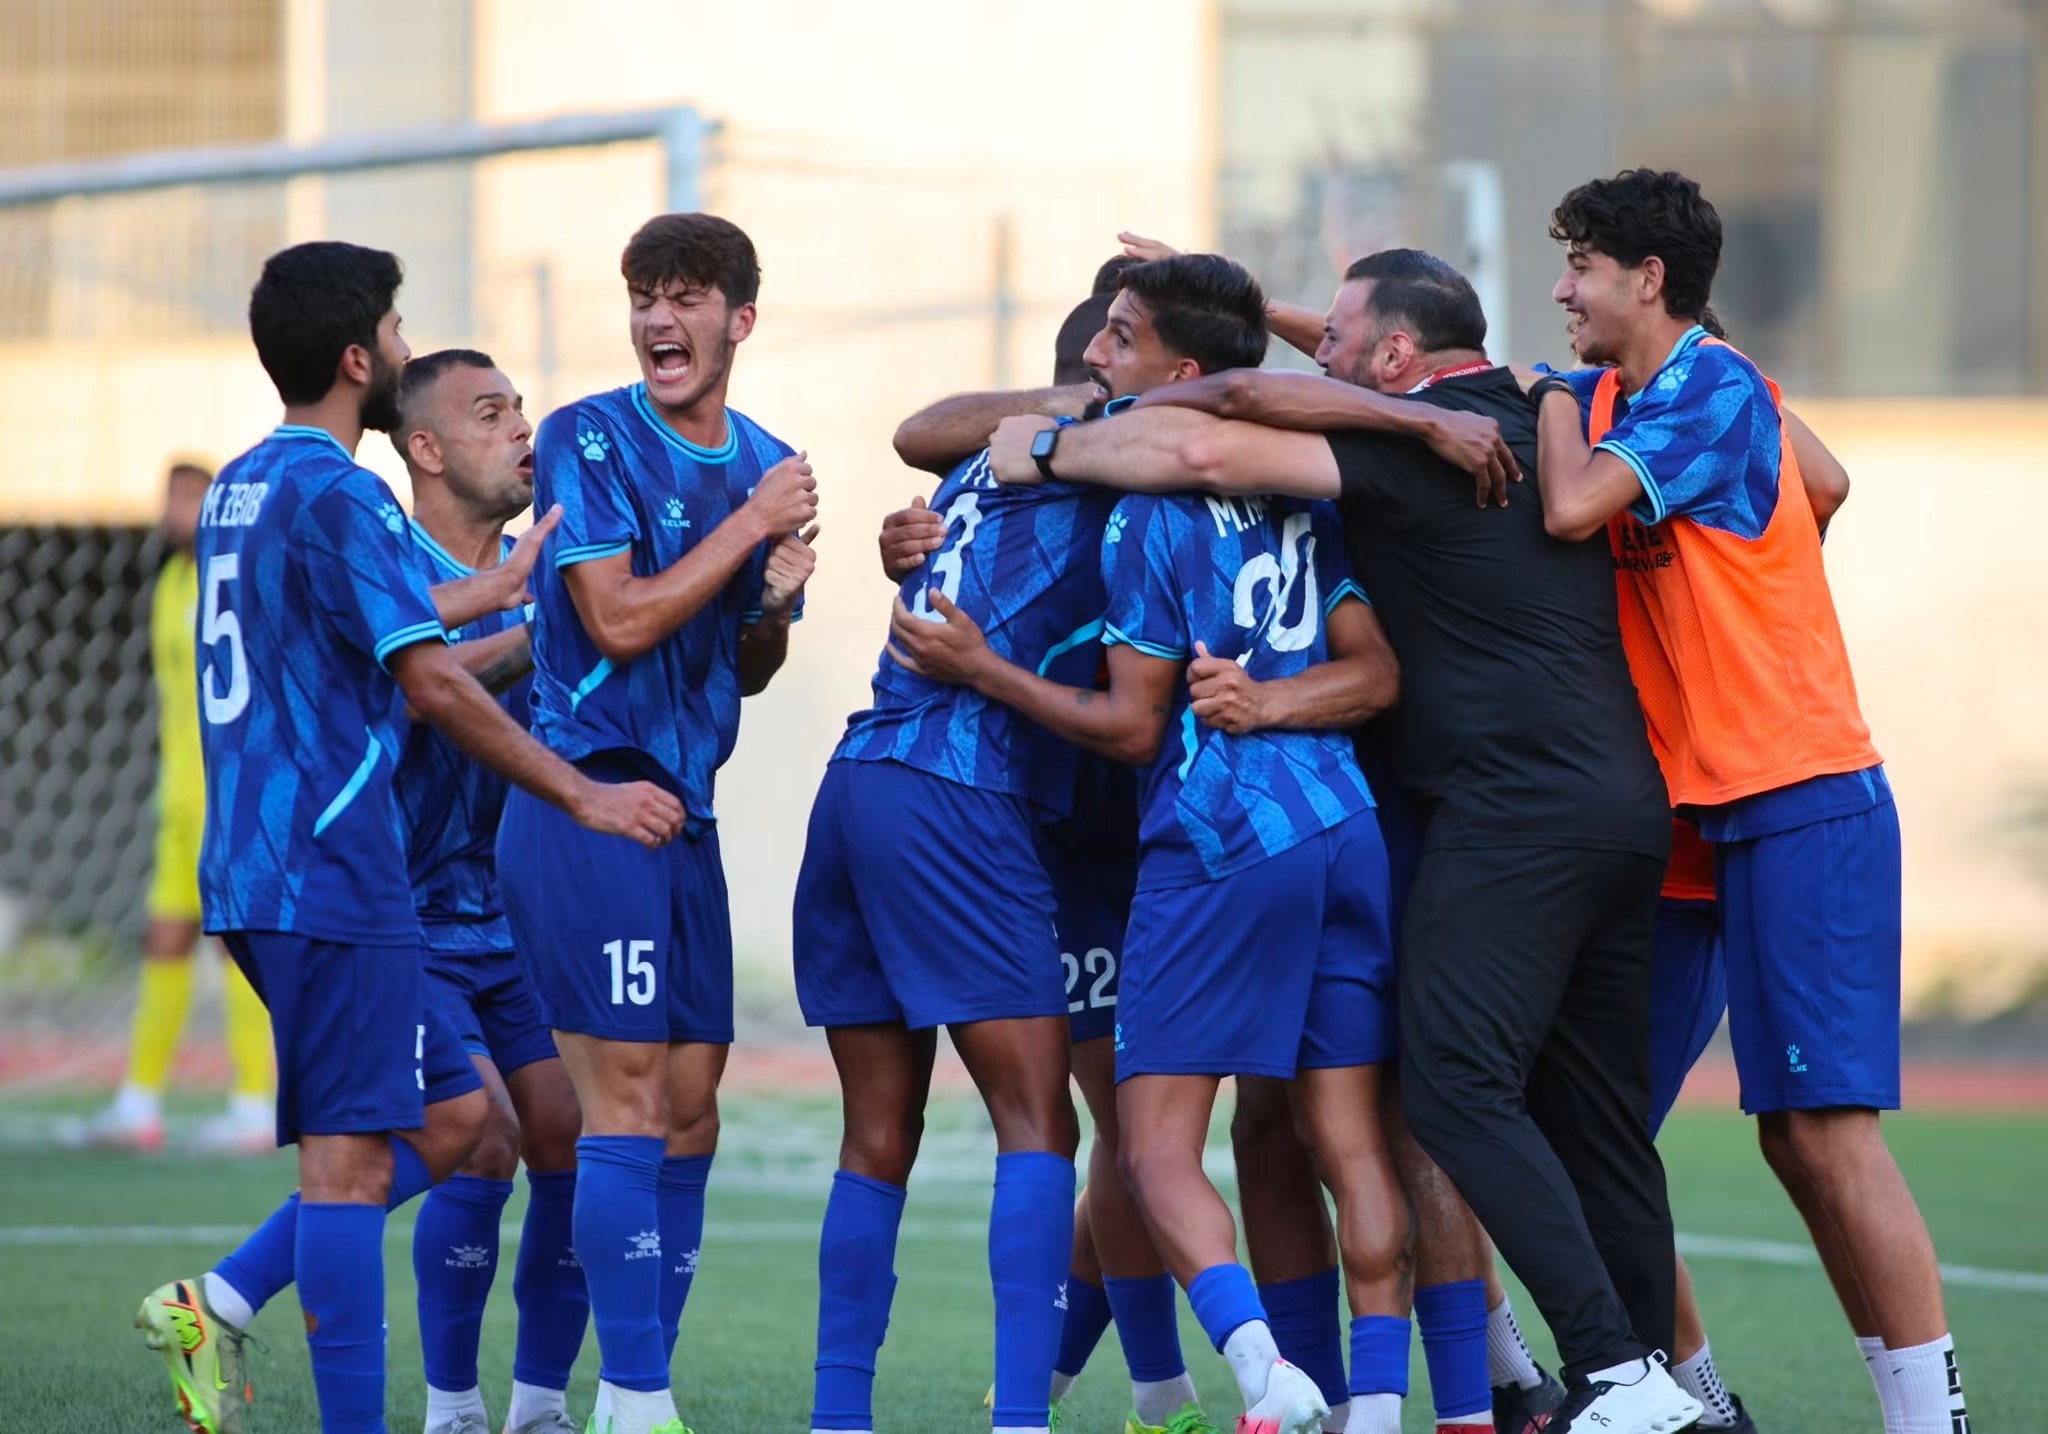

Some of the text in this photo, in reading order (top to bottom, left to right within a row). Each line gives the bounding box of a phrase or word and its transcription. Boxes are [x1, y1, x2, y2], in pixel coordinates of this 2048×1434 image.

[202, 553, 250, 725] 5
[603, 939, 656, 1006] 15
[1060, 947, 1118, 1013] 22
[445, 1258, 489, 1268] KELM
[624, 1248, 662, 1260] KELM
